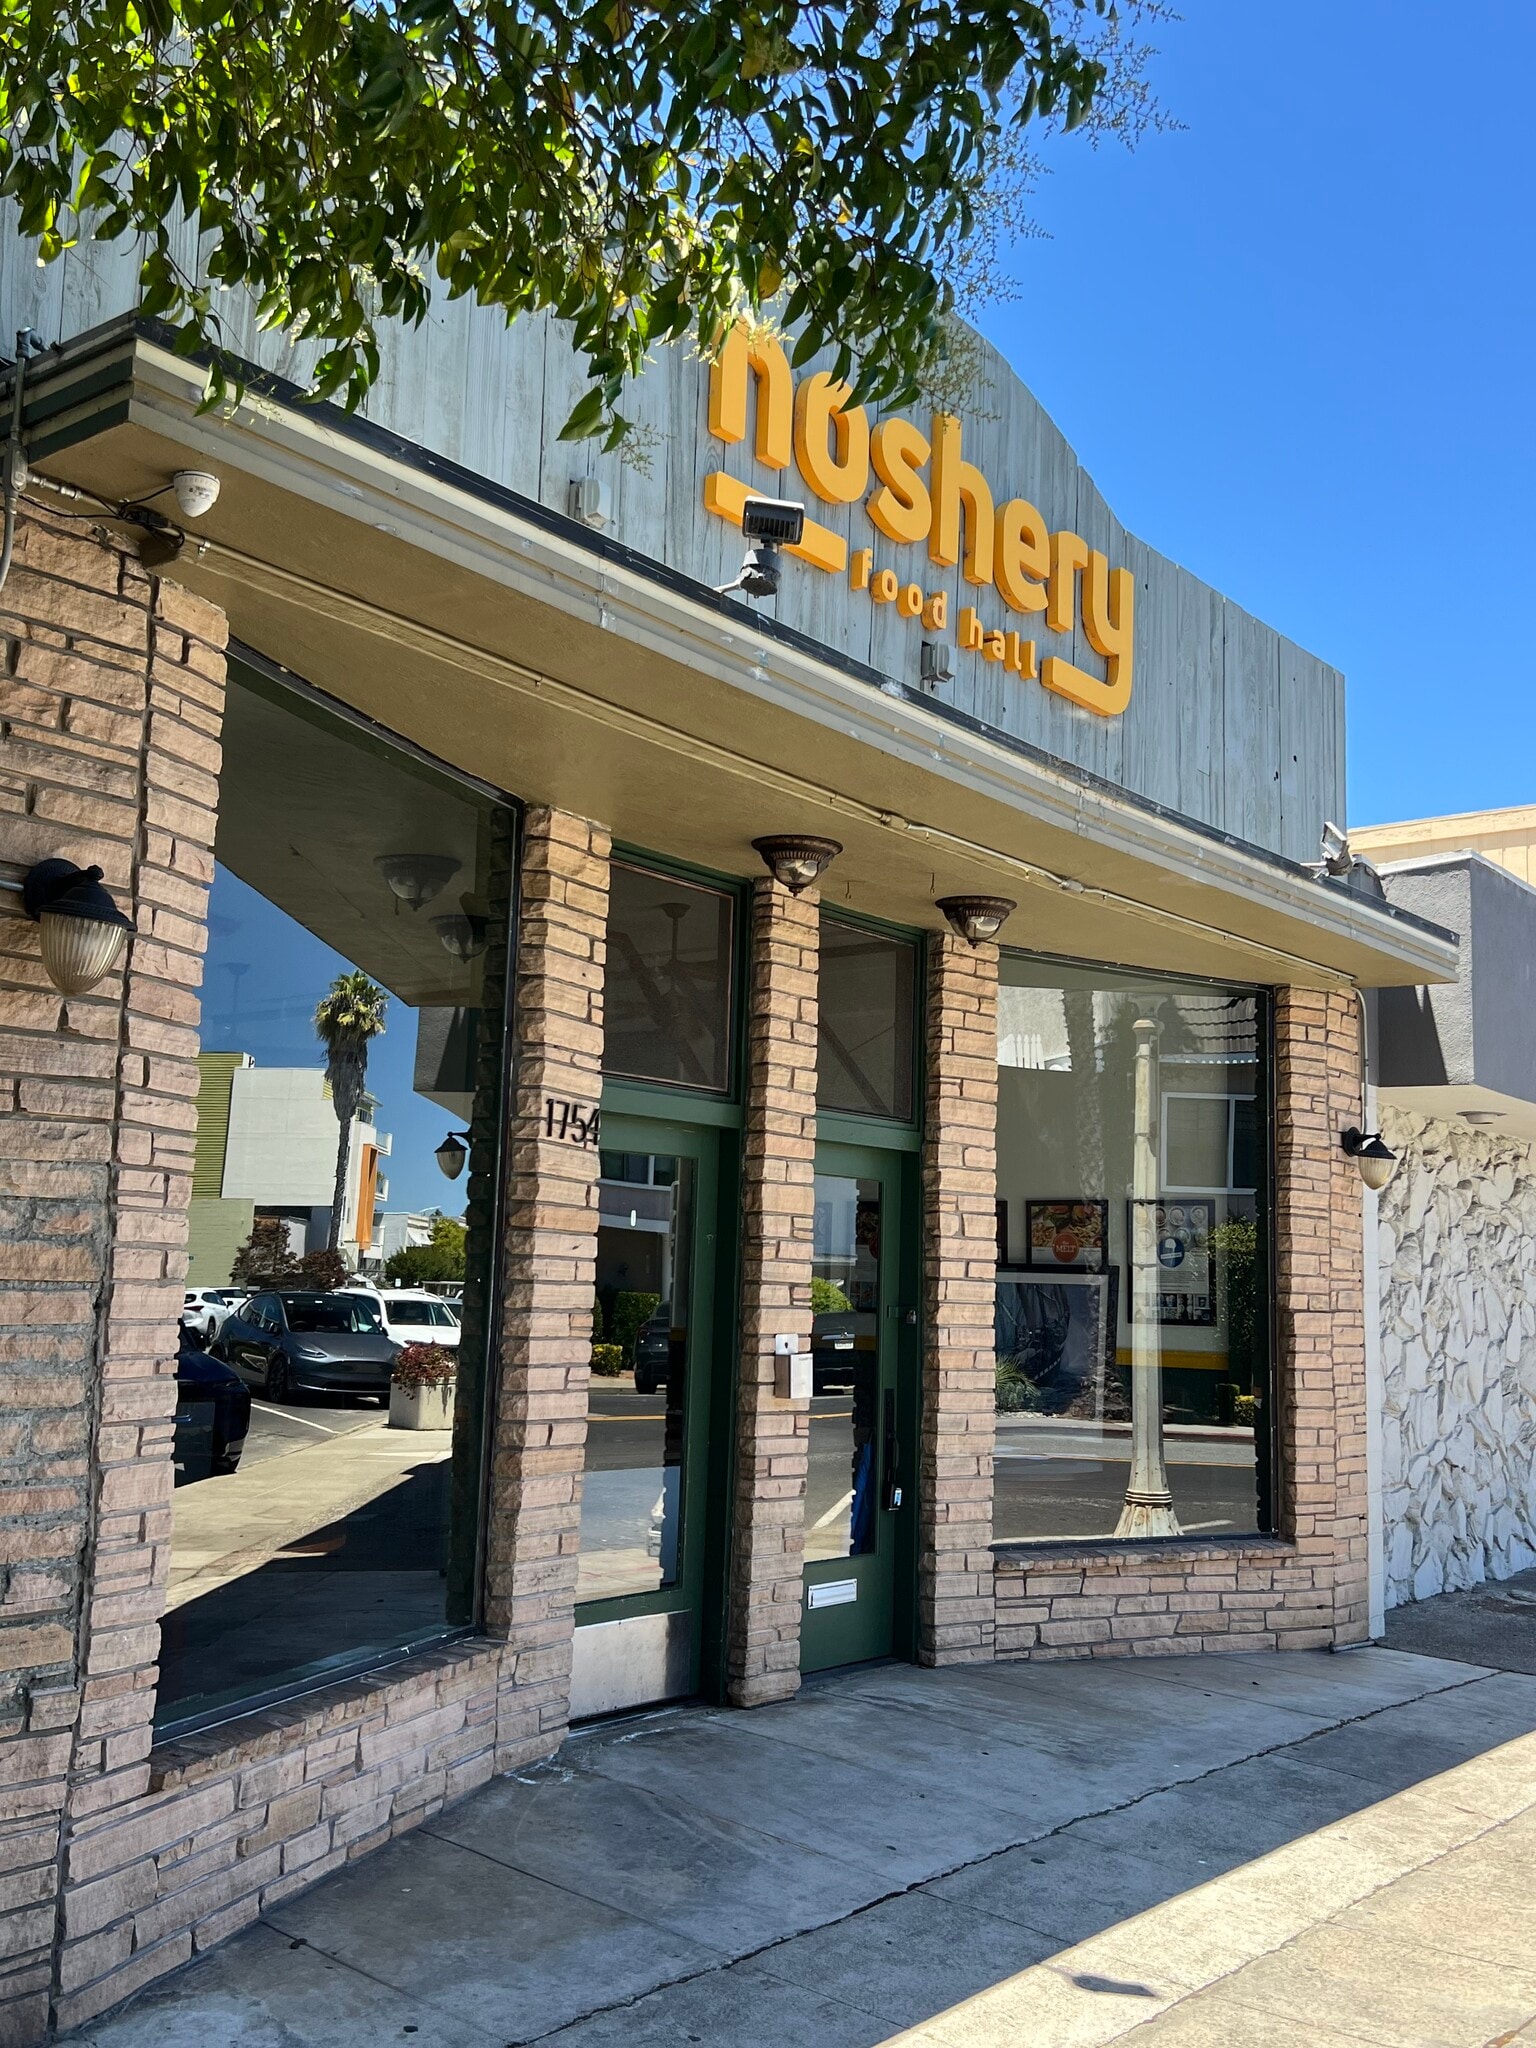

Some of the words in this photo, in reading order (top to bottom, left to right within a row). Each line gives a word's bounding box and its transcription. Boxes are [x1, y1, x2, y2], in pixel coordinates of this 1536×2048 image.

[707, 313, 1134, 716] noshery
[850, 548, 948, 631] food
[957, 606, 1038, 681] hall
[546, 1098, 600, 1146] 1754
